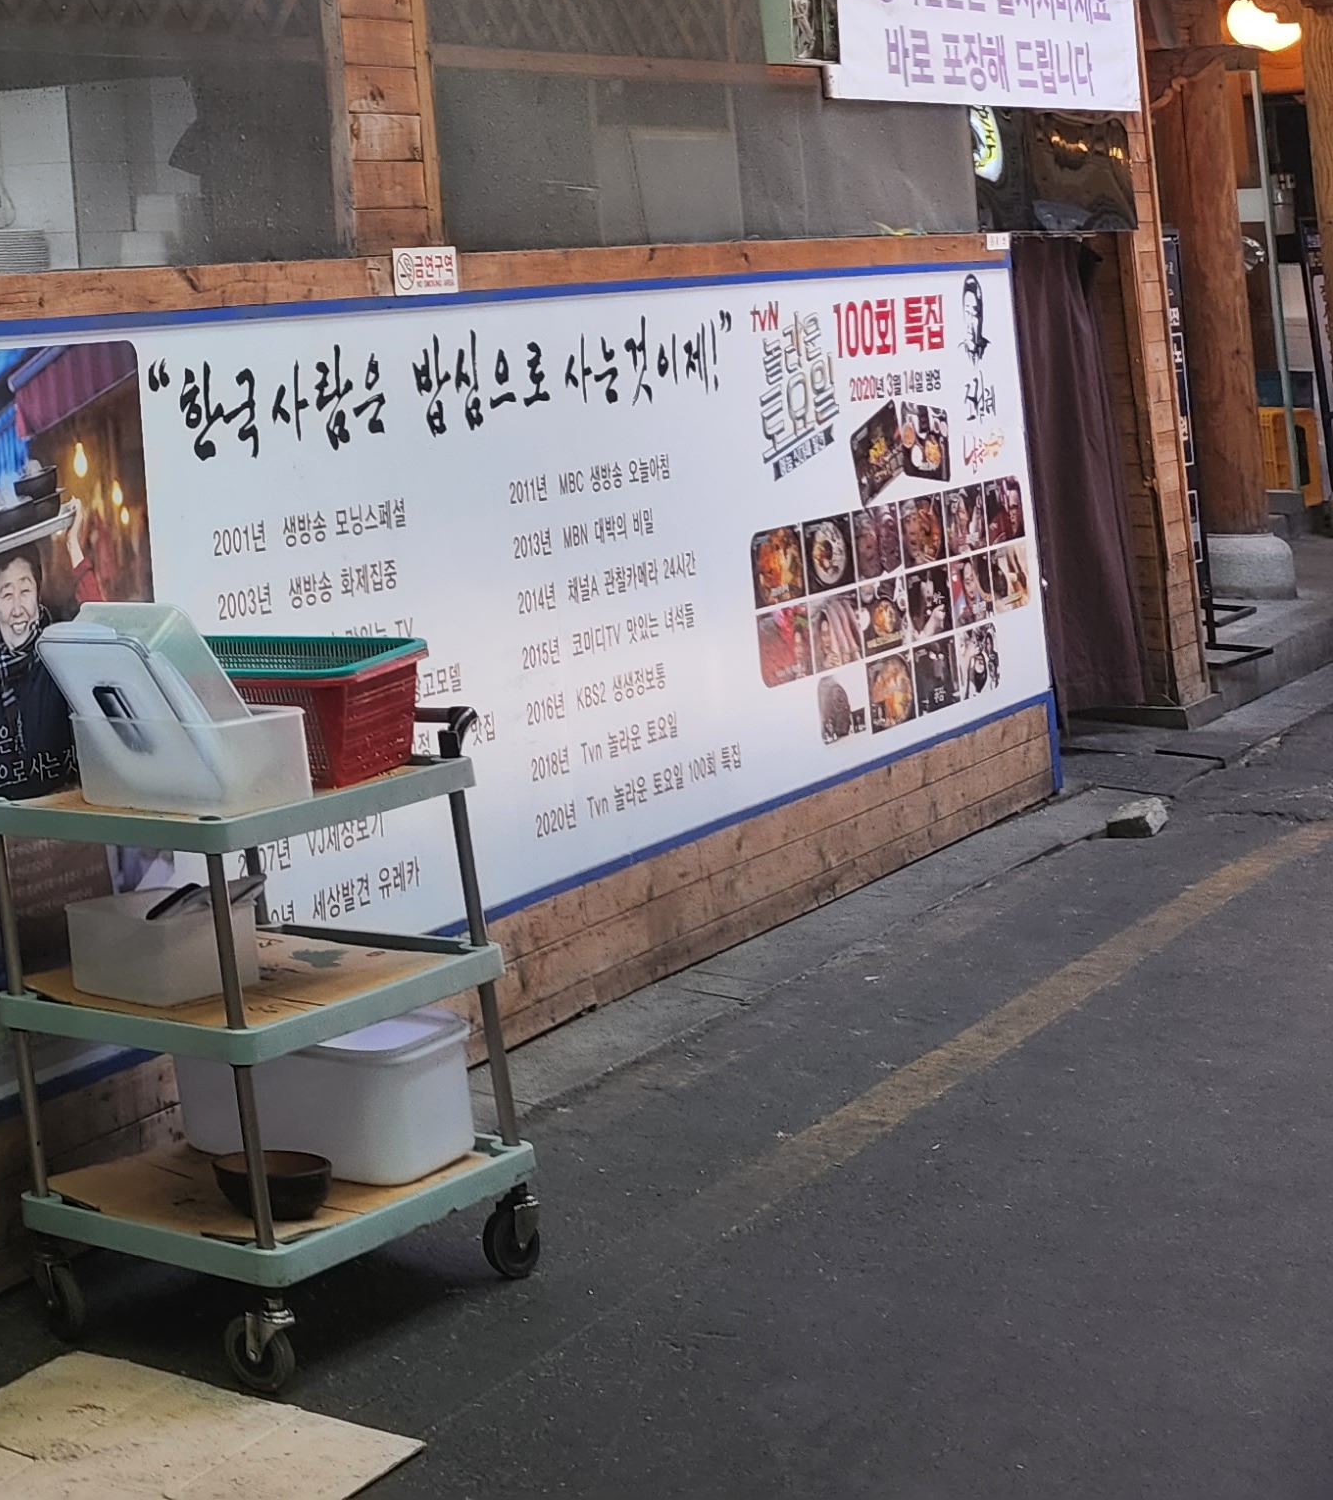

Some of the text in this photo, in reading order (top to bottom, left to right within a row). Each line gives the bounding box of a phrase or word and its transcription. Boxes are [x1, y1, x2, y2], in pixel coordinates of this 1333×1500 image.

[885, 25, 1095, 97] 바로 포장해 드립니다
[415, 255, 454, 278] 금연구역
[750, 301, 779, 333] tvN
[833, 294, 945, 358] 100회 특집
[412, 329, 551, 438] 밥심으로
[850, 375, 884, 402] 2020년
[903, 369, 924, 394] 14일
[509, 453, 671, 504] 2011년 MBC 생방송 오늘아침
[213, 497, 407, 557] 2001년 생방송 모닝스페셜
[513, 507, 655, 559] 2013년 MBN 대박의 비밀
[218, 559, 398, 621] 2003년 생방송 화제집중
[518, 550, 696, 614] 2014년 채널A 관찰카메라 24시간
[522, 602, 695, 670] 2015년 코미디TV 맛있는 녀석들
[527, 662, 666, 726] 2016년 KBS2 생생정보통
[531, 710, 678, 782] 2018년 Tvn 놀라운 토요일
[535, 742, 742, 838] 2020년 Tvn 놀라운 토요일 100회 특집
[312, 873, 371, 922] 세상발견
[378, 856, 420, 900] 유레카
